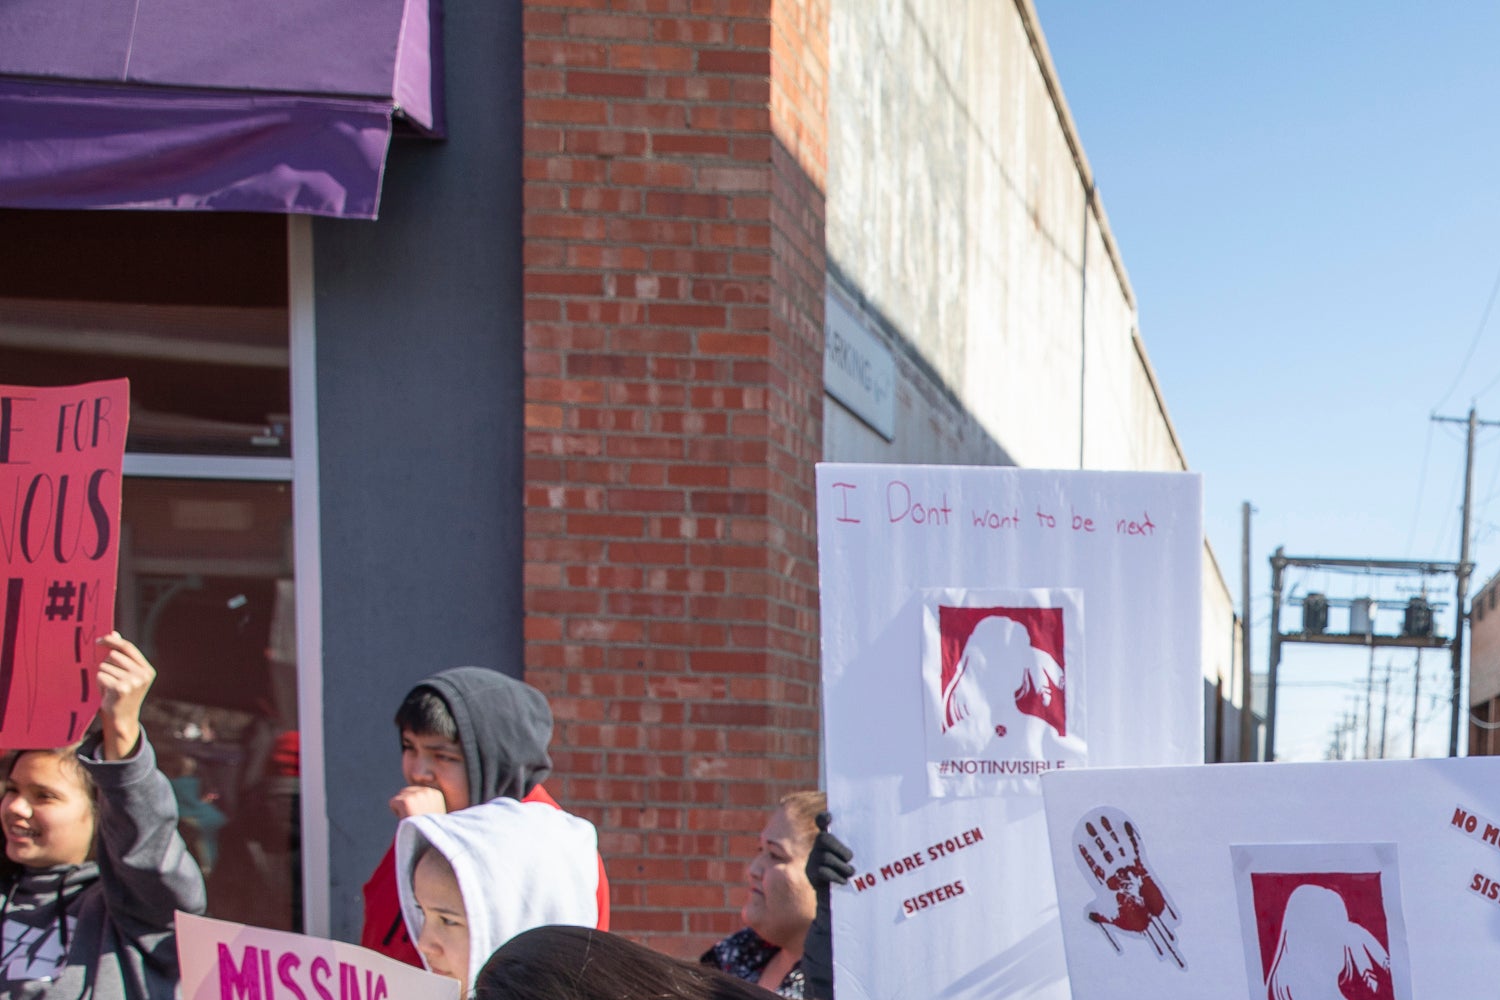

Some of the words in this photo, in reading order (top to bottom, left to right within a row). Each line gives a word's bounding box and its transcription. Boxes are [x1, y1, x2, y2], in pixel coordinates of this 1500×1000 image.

[55, 395, 113, 453] FOR
[832, 481, 861, 524] I
[886, 480, 952, 526] Dont
[1036, 503, 1057, 529] to
[1071, 504, 1097, 534] be
[1117, 511, 1156, 537] next
[1451, 807, 1478, 833] NO
[854, 872, 876, 893] NO
[880, 852, 925, 882] MORE
[927, 826, 984, 862] STOLEN
[903, 880, 965, 914] SISTERS
